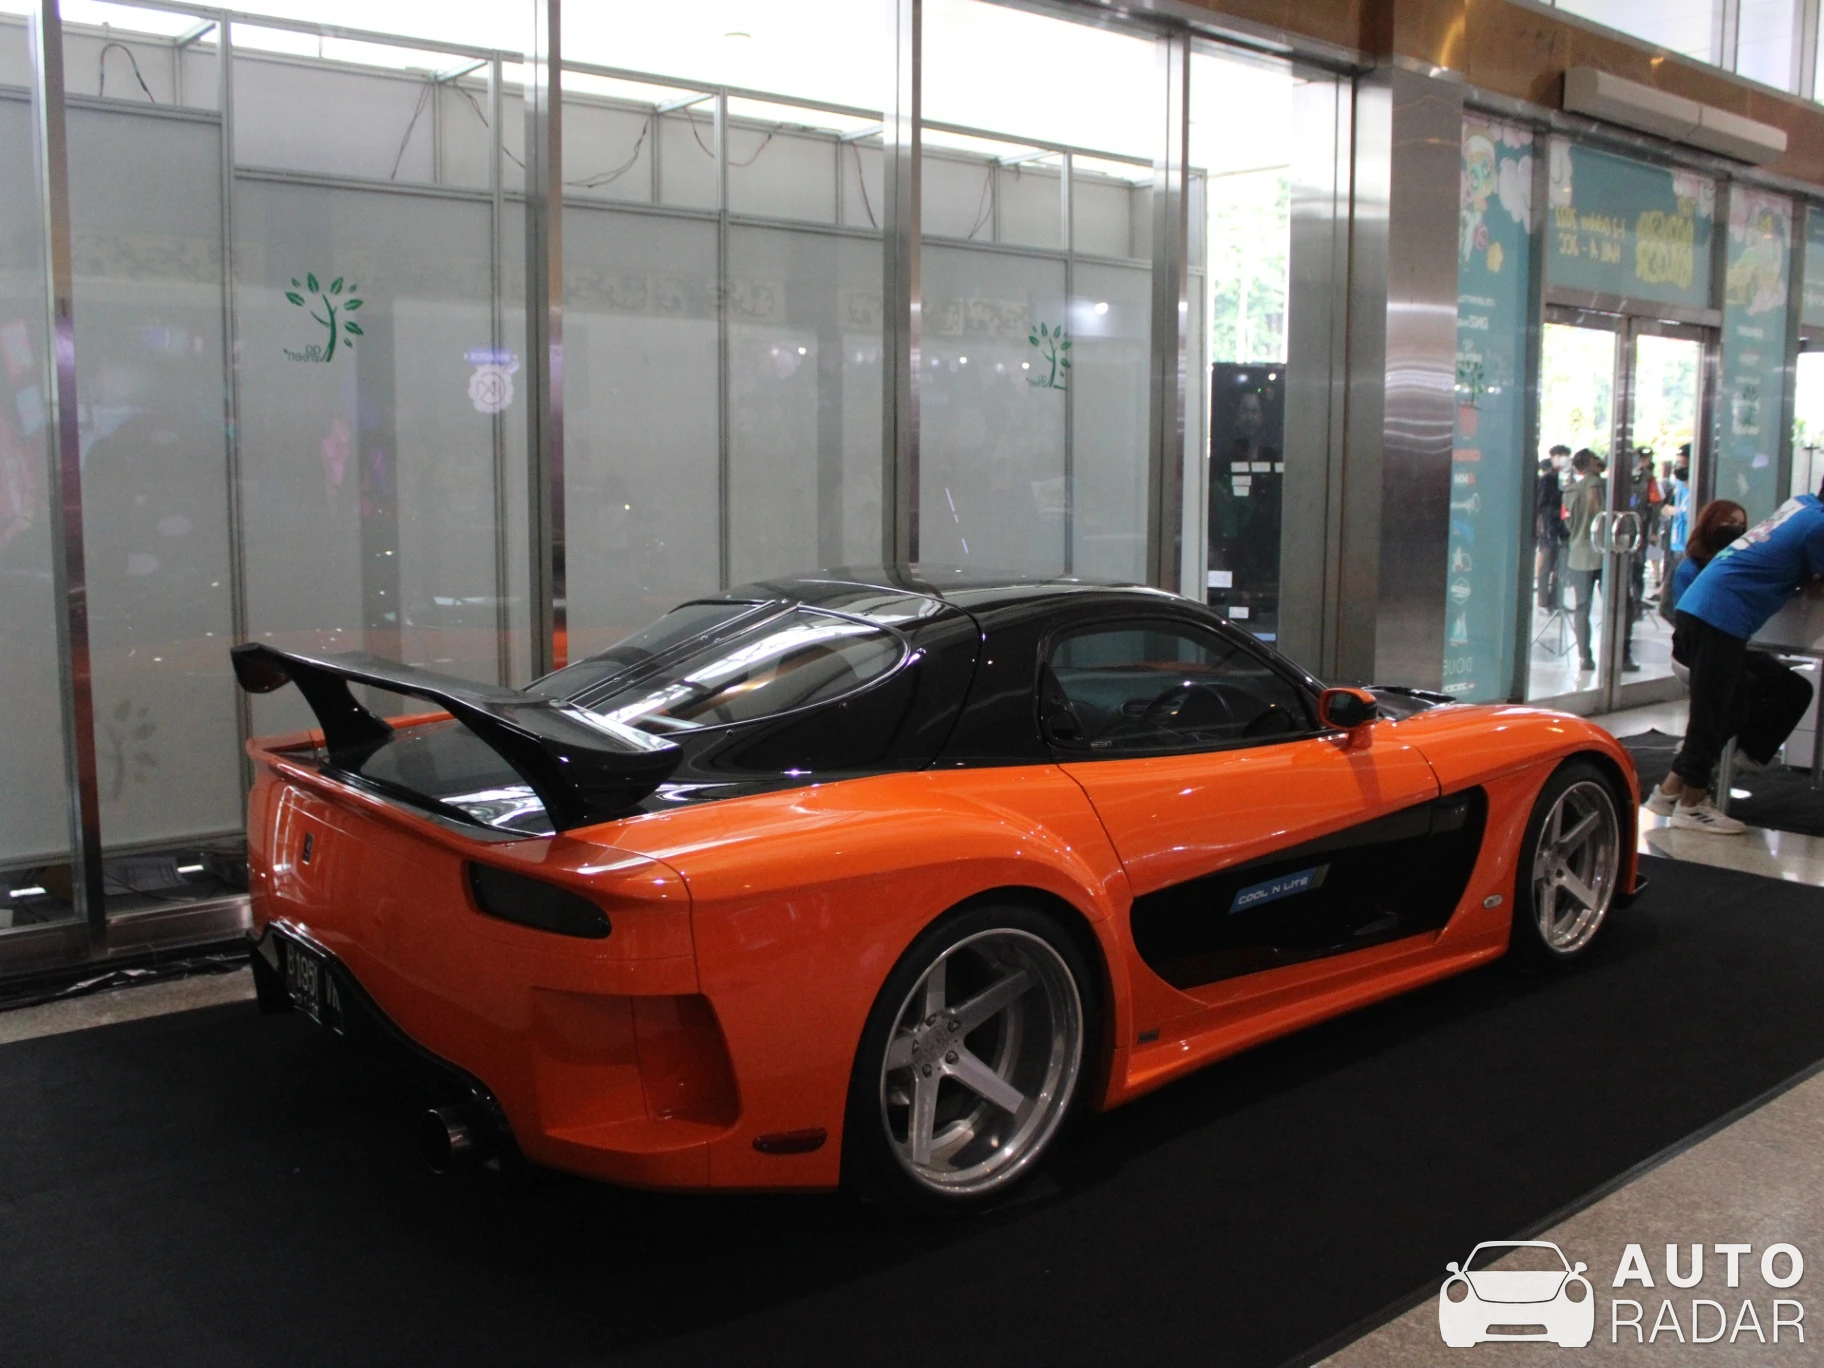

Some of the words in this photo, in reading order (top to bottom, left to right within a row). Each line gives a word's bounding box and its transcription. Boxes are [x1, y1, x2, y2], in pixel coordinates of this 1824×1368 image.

[1238, 889, 1268, 905] COOL
[1272, 885, 1280, 894] N
[1283, 877, 1309, 890] LITE
